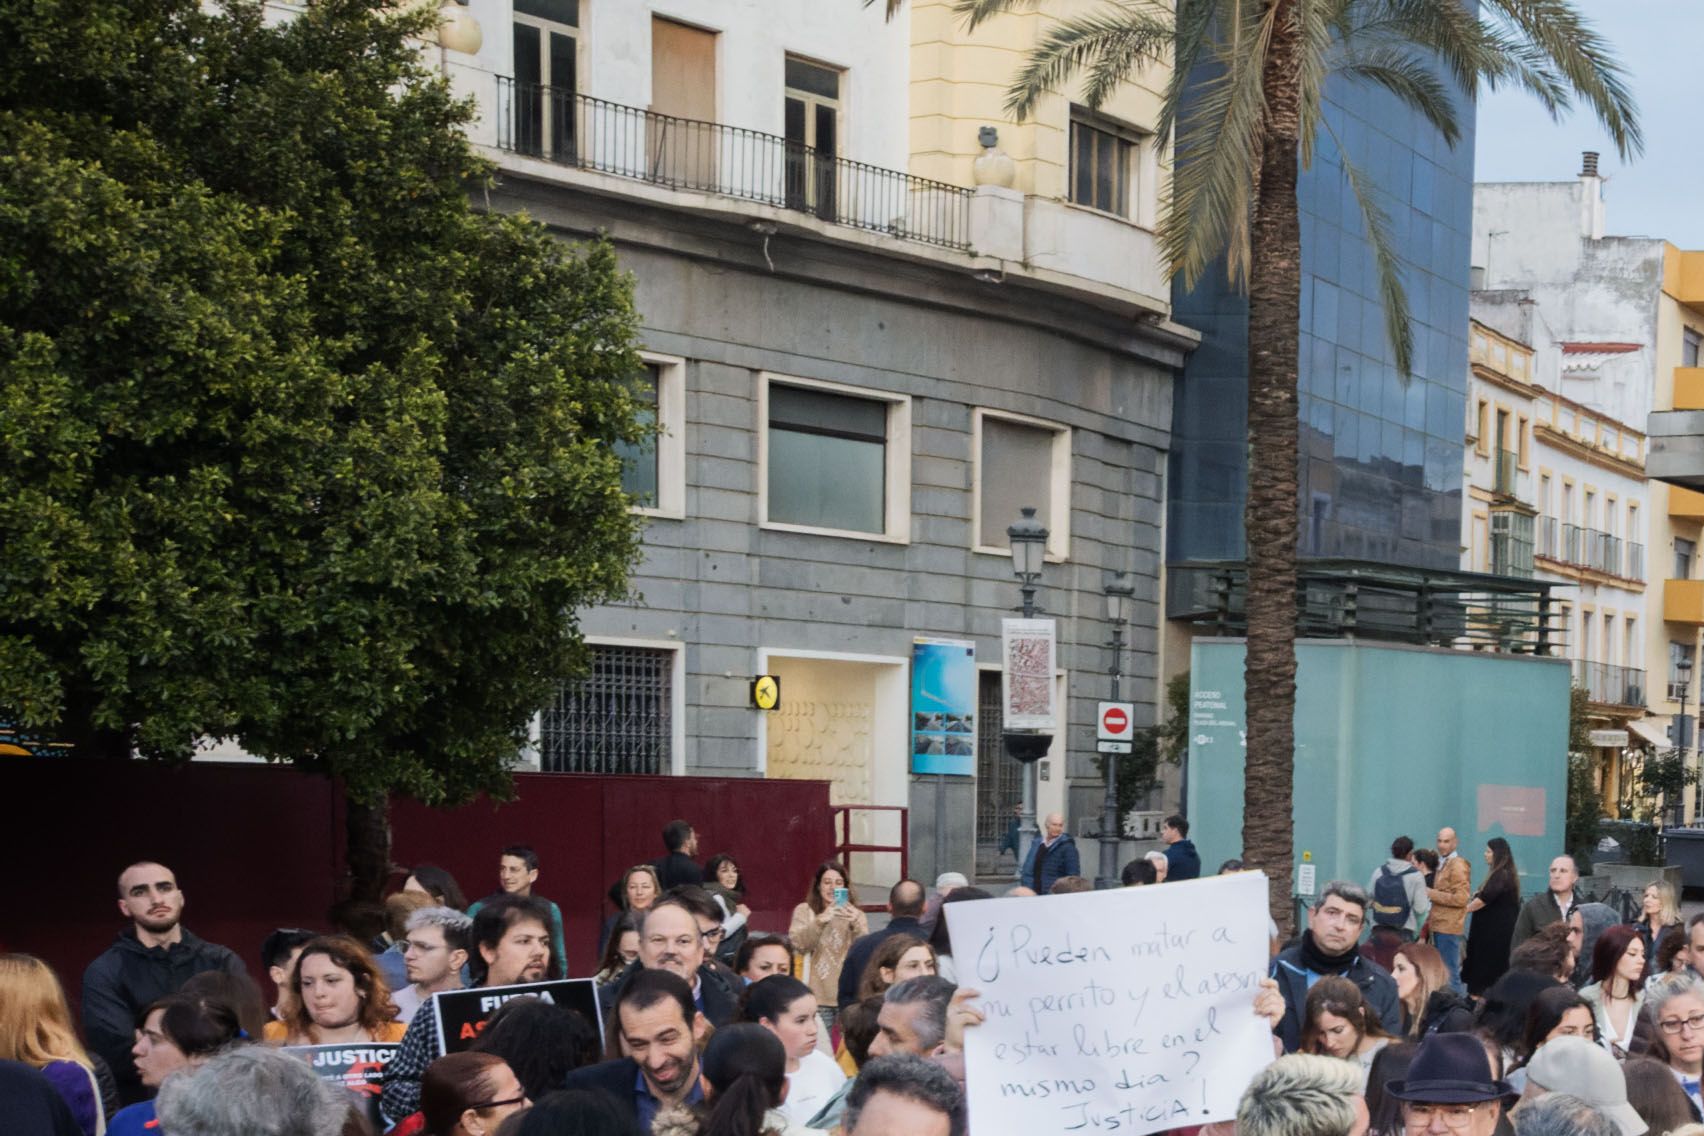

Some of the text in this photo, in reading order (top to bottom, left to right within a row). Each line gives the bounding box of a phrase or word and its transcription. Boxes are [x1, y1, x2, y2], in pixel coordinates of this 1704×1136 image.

[1131, 920, 1197, 960] matar
[1211, 926, 1240, 945] a
[1028, 978, 1116, 1034] perrito
[1128, 986, 1150, 1027] y
[1162, 963, 1192, 999] el
[994, 1005, 1221, 1064] estar libre en el
[1000, 1077, 1097, 1098] mismo
